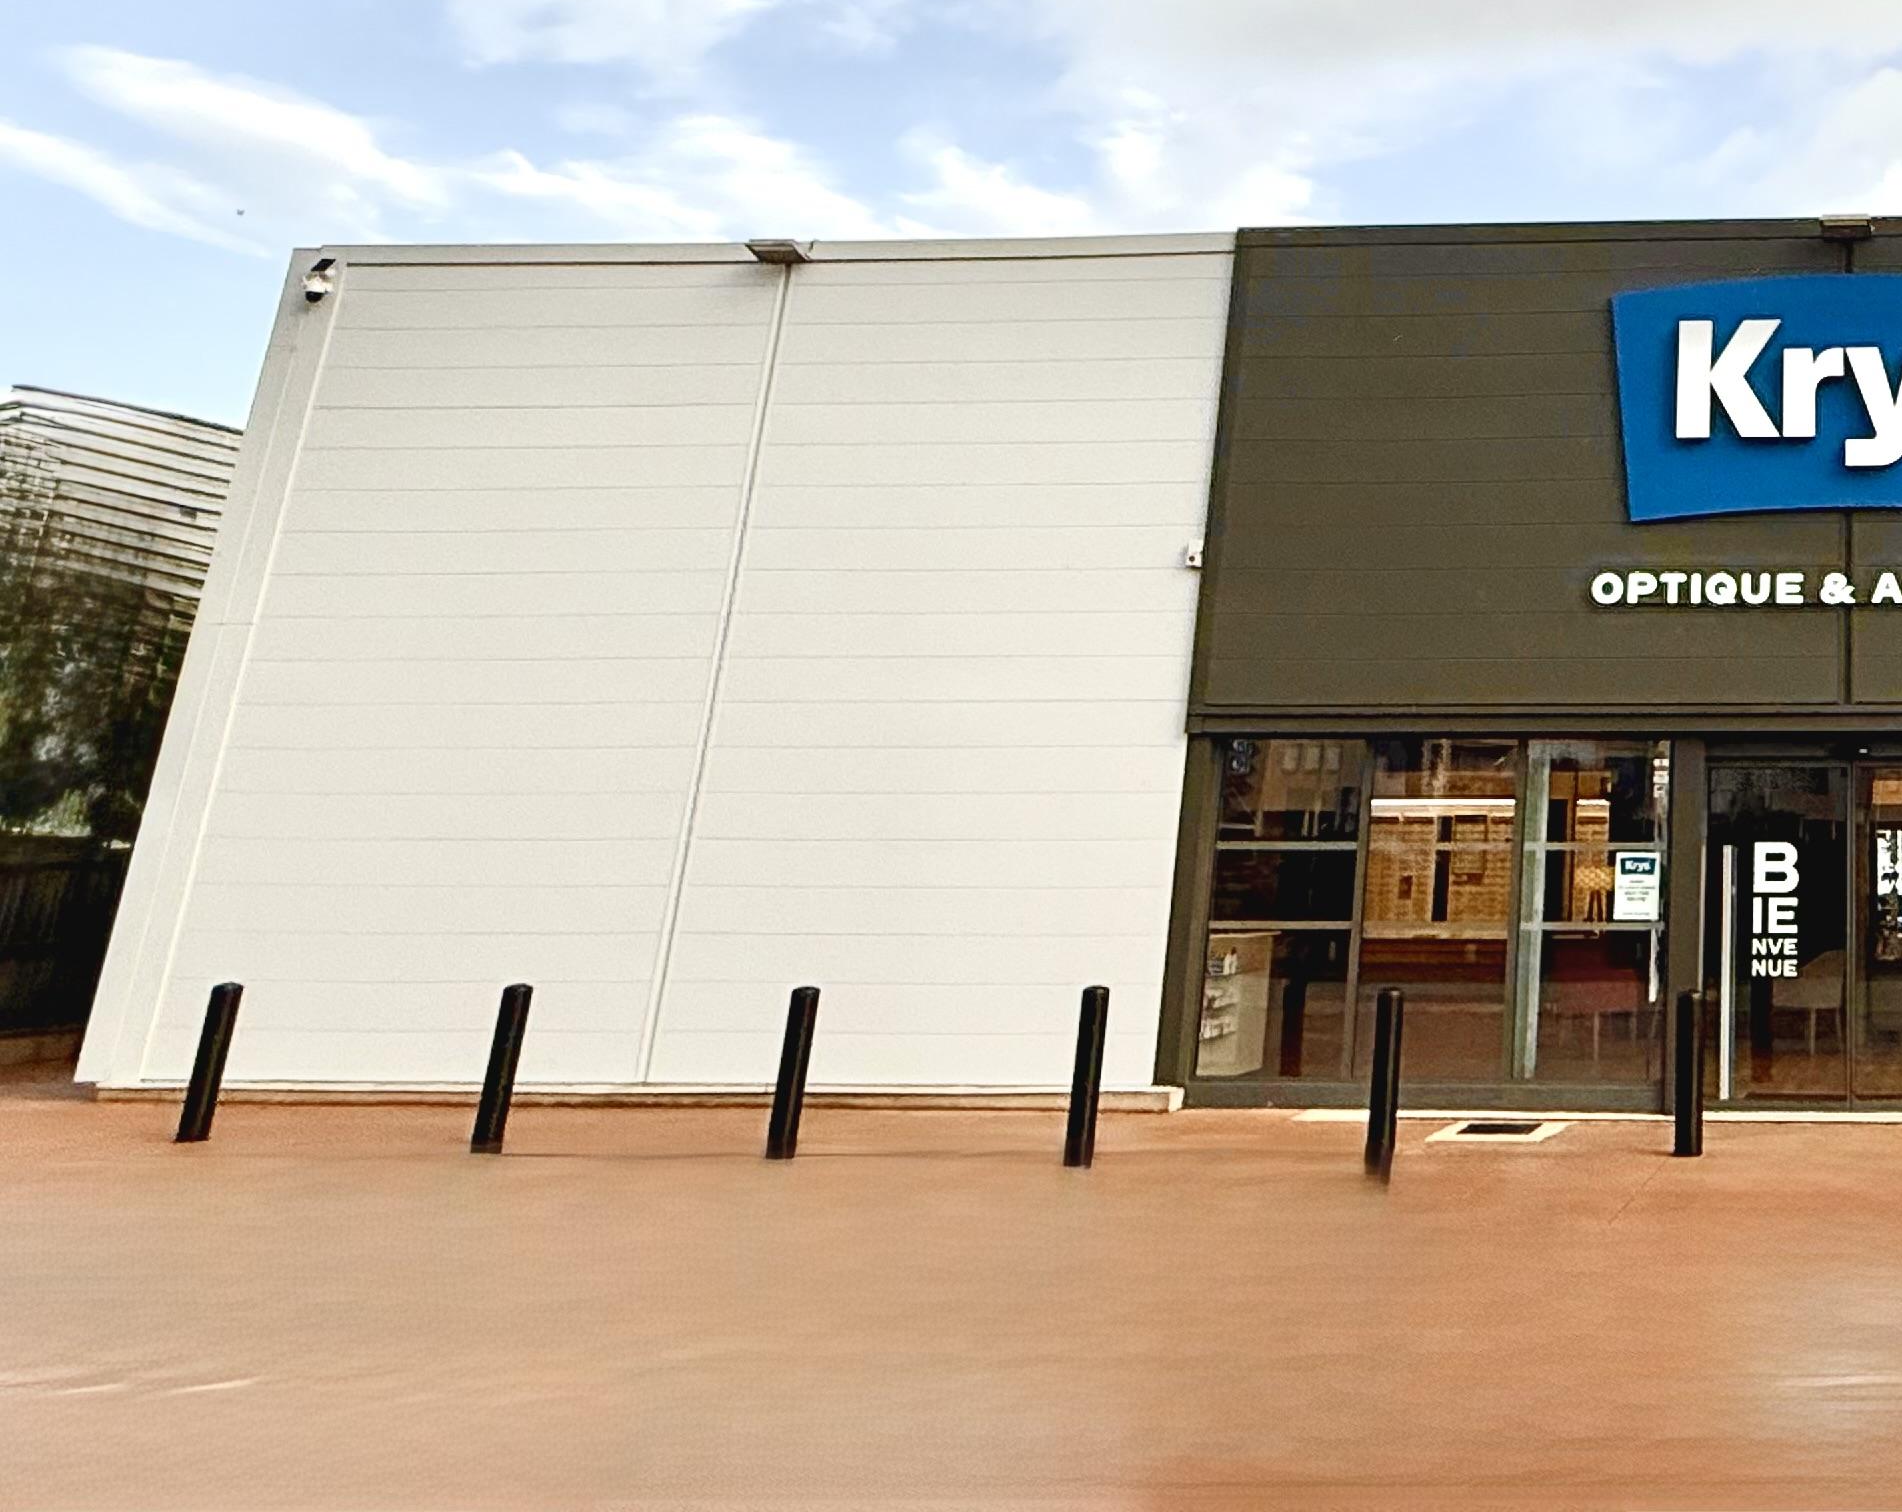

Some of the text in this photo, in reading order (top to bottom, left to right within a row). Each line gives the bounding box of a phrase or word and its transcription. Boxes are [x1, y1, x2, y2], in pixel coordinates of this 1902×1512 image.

[1591, 571, 1804, 605] OPTIQUE
[1819, 572, 1856, 605] &
[1752, 841, 1800, 894] B
[1752, 896, 1799, 934] IE
[1751, 937, 1799, 956] NVE
[1751, 958, 1799, 978] NUE
